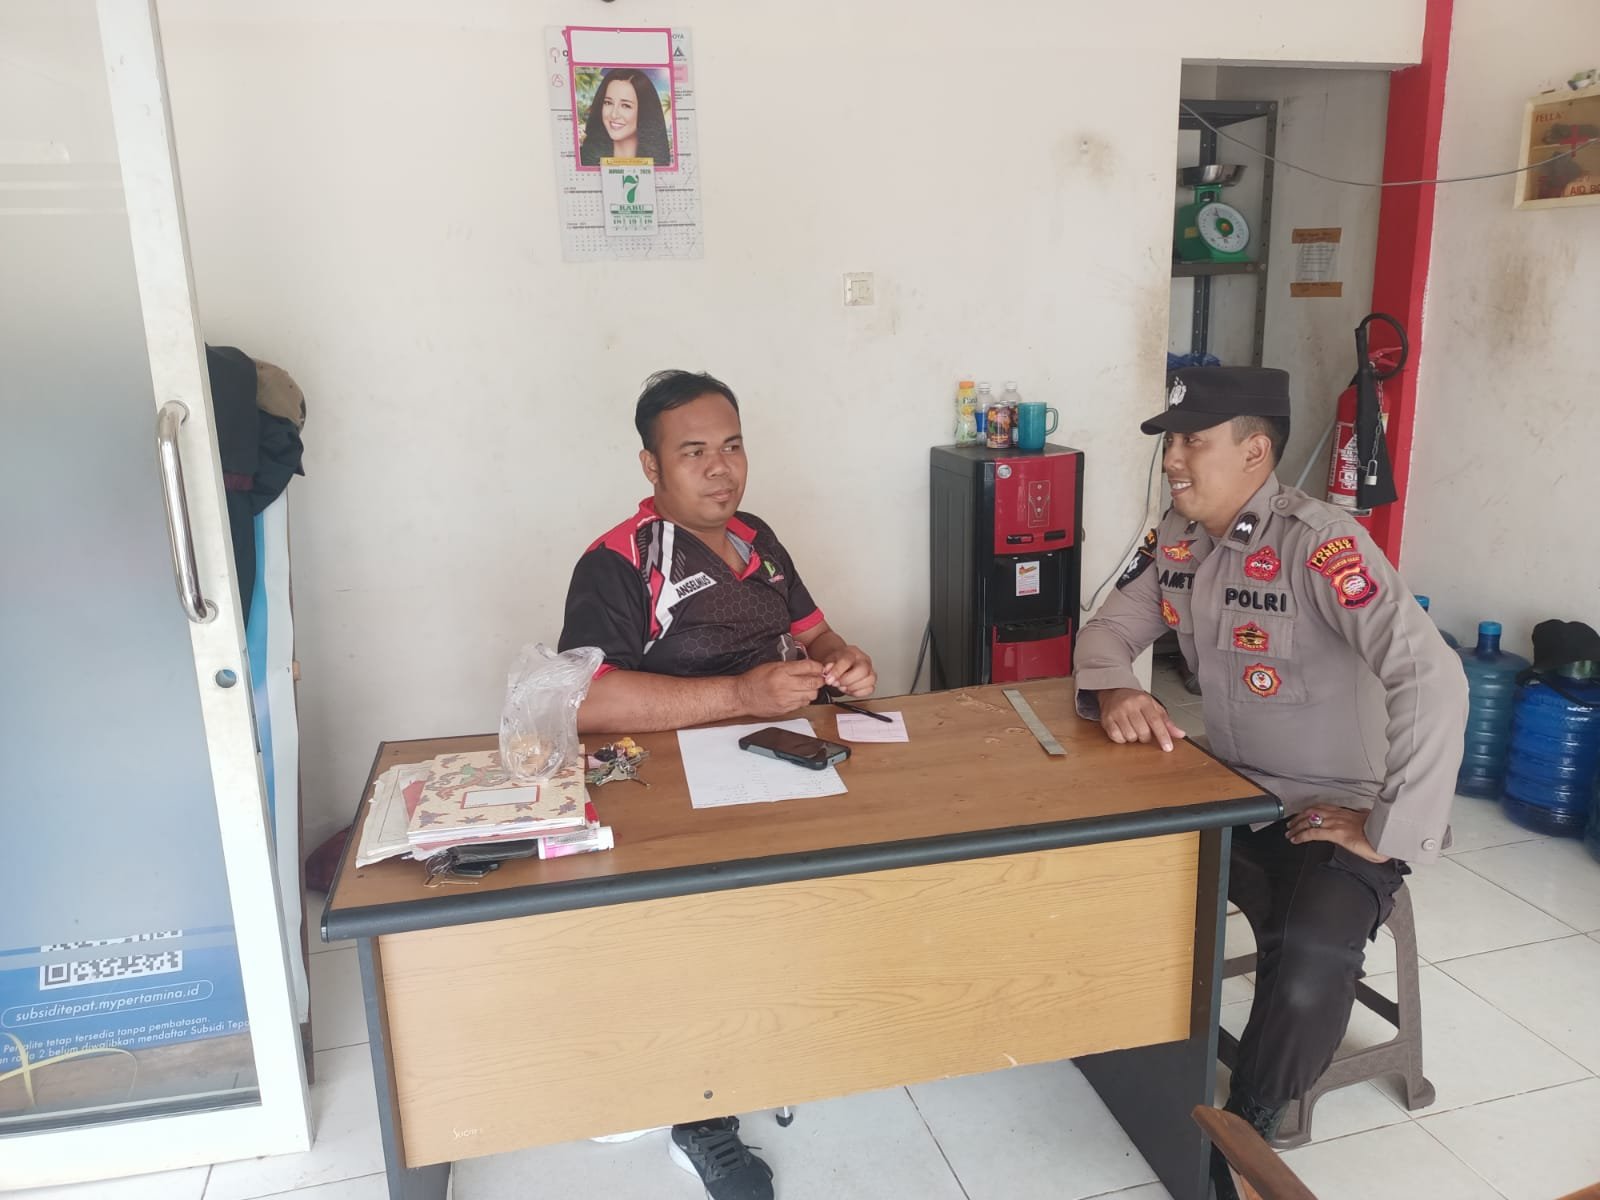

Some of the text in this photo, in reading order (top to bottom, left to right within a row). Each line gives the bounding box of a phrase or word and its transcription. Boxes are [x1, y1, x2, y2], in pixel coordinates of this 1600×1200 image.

[622, 175, 639, 204] 7
[1570, 185, 1586, 195] AID
[1313, 543, 1353, 567] LANDAK
[675, 574, 712, 599] ANSELMUS
[1225, 587, 1288, 612] POLRI
[15, 984, 200, 1023] subsiditepat.mypertamina.id
[3, 1016, 209, 1053] Peralite tetap tersedia tanpa pembatasan.
[39, 1049, 46, 1059] 2
[49, 1046, 78, 1058] belum
[137, 1030, 187, 1043] mendaftar
[190, 1022, 225, 1035] Subsidi
